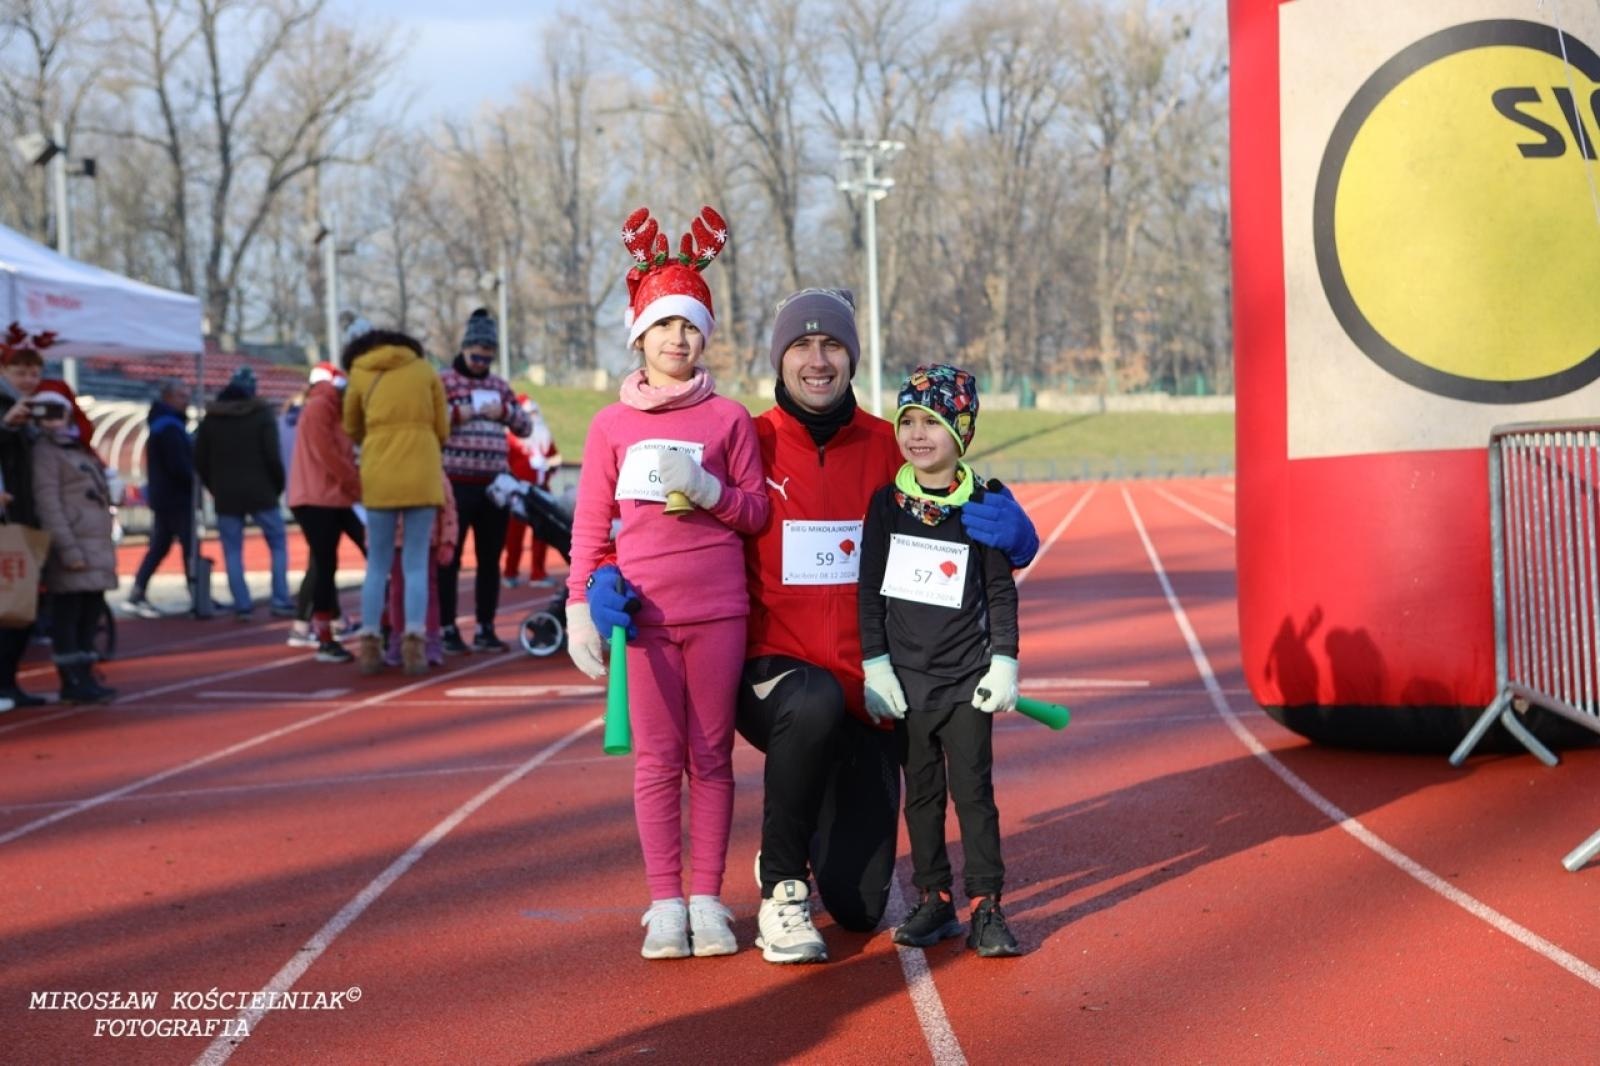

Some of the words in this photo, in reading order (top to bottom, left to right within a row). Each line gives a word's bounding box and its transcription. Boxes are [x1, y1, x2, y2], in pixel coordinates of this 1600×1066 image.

[1491, 86, 1600, 160] SI
[790, 525, 807, 533] BIEG
[896, 538, 911, 547] BIEG
[816, 551, 835, 566] 59
[913, 568, 933, 584] 57
